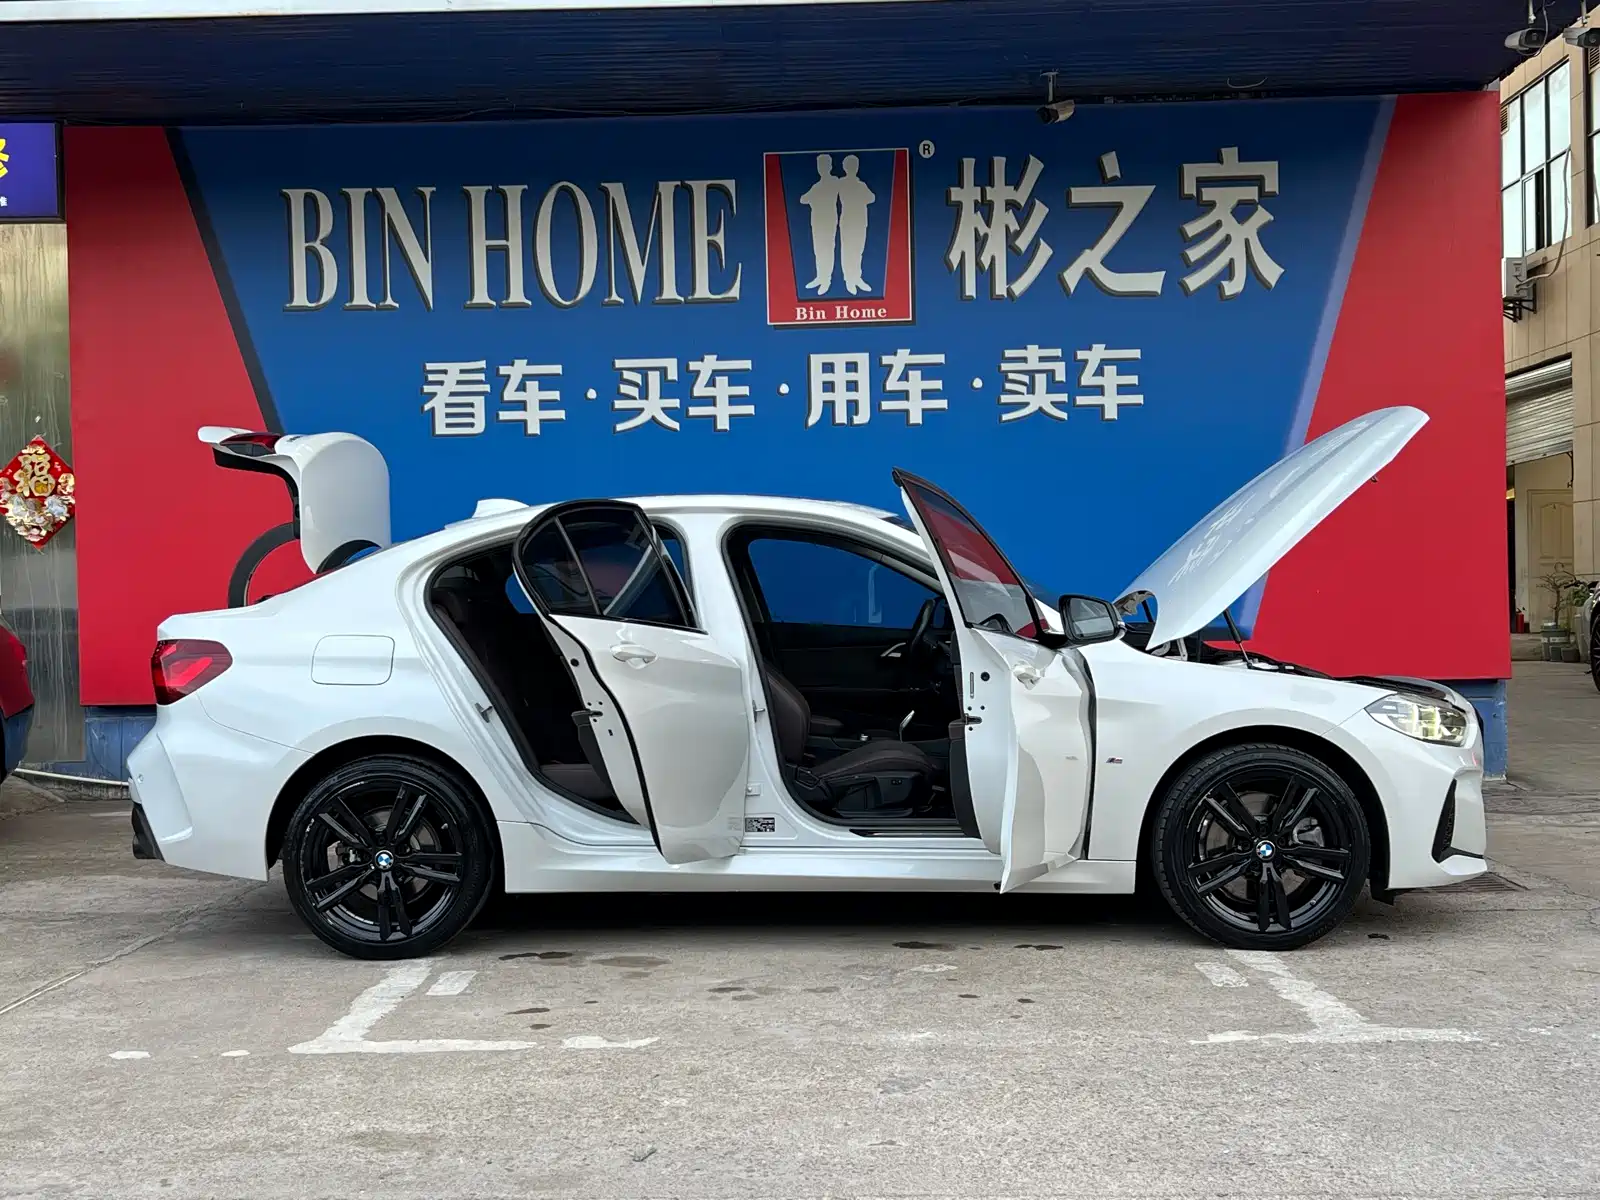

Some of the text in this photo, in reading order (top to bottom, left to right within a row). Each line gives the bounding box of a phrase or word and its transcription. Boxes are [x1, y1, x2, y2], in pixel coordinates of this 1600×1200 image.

[281, 178, 743, 312] BIN HOME
[946, 146, 1284, 302] 彬之家
[795, 304, 888, 321] Bin Home
